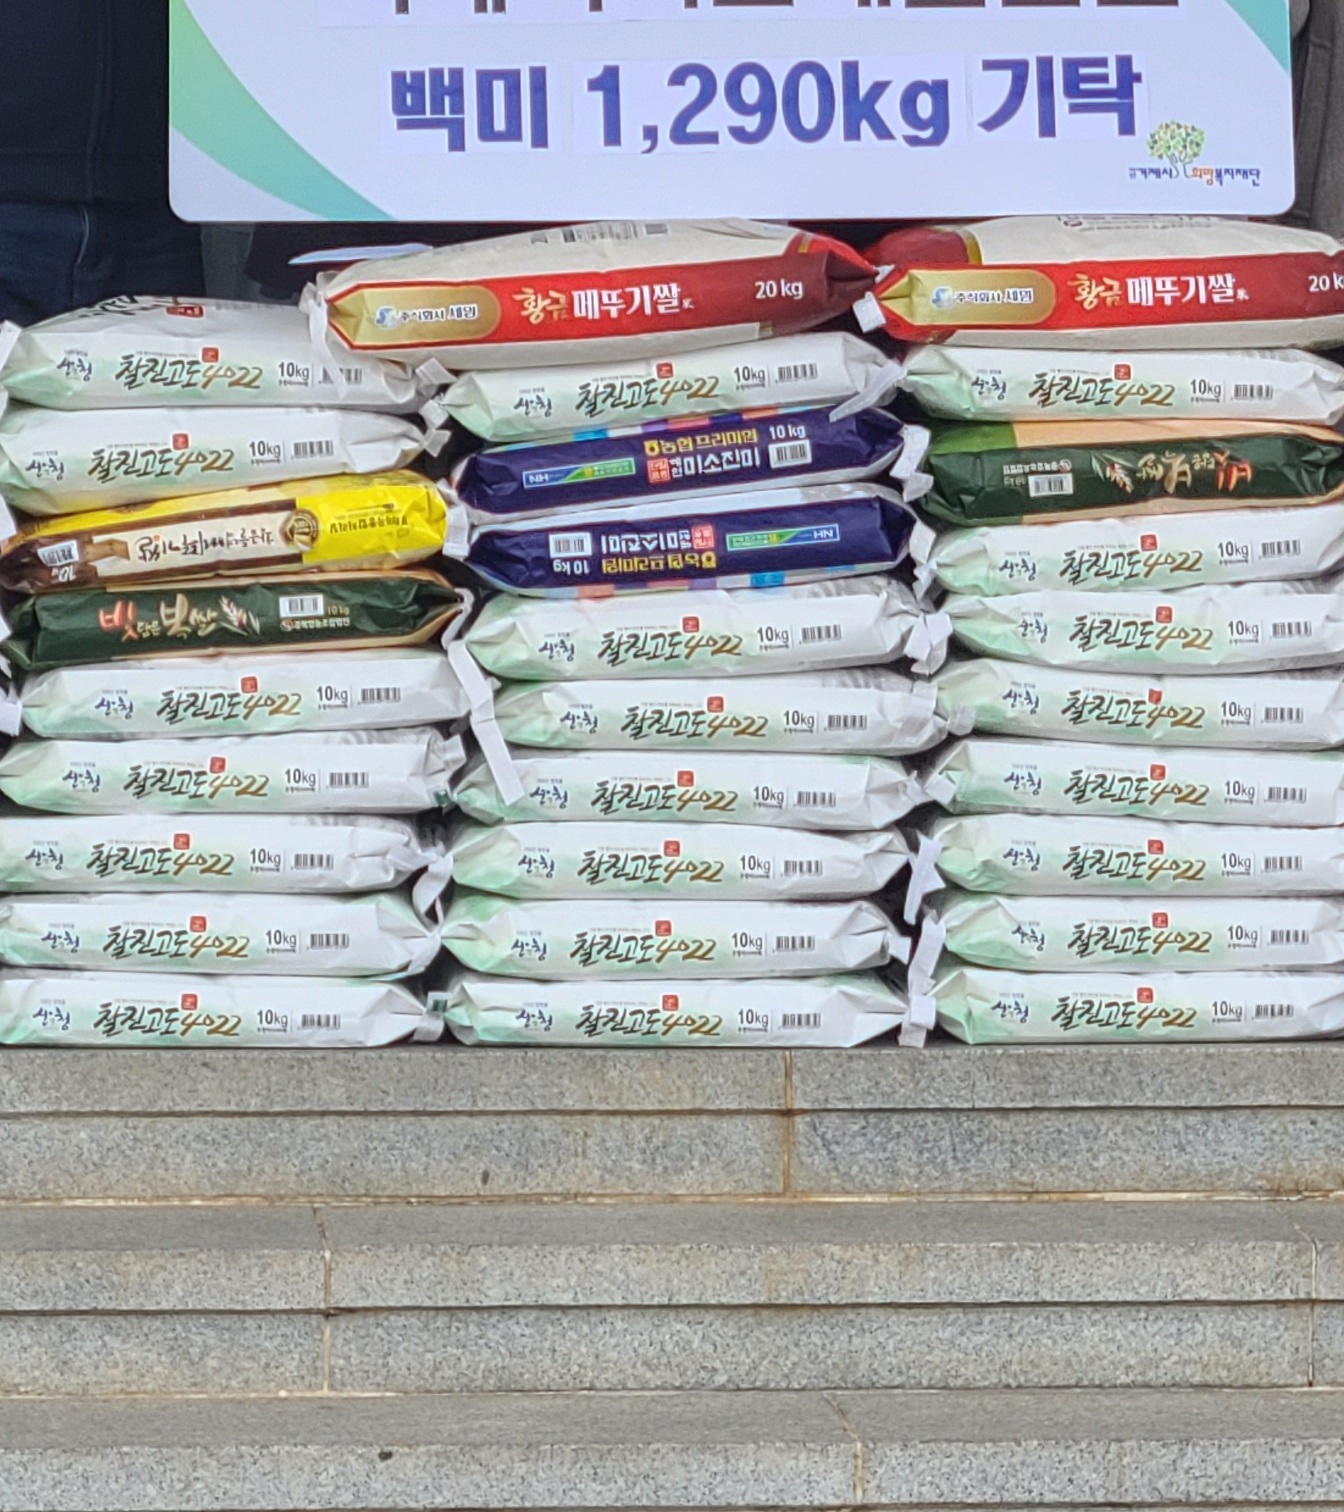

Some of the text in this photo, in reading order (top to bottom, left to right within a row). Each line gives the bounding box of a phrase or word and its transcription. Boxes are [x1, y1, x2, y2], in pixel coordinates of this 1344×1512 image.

[390, 53, 1142, 154] 백미 1,290kg 기탁
[1126, 272, 1235, 304] 메뚜기쌀
[572, 283, 681, 318] 메뚜기쌀
[278, 362, 309, 380] 10kg
[1190, 380, 1221, 399] 10kg
[695, 429, 757, 450] 프리미엄
[250, 441, 280, 459] 10kg
[684, 449, 760, 476] 미소진미
[603, 534, 680, 555] 미소진미
[603, 555, 664, 573] 프리미엄
[757, 627, 789, 644] 10kg
[1228, 620, 1259, 638] 10kg
[784, 710, 814, 729] 10kg
[1221, 702, 1251, 720] 10kg
[285, 769, 316, 787] 10kg
[740, 856, 770, 874] 10kg
[1221, 854, 1251, 872] 10kg
[265, 930, 296, 949] 10kg
[257, 1009, 288, 1028] 10kg
[738, 1009, 769, 1028] 10kg
[1212, 1001, 1242, 1020] 10kg
